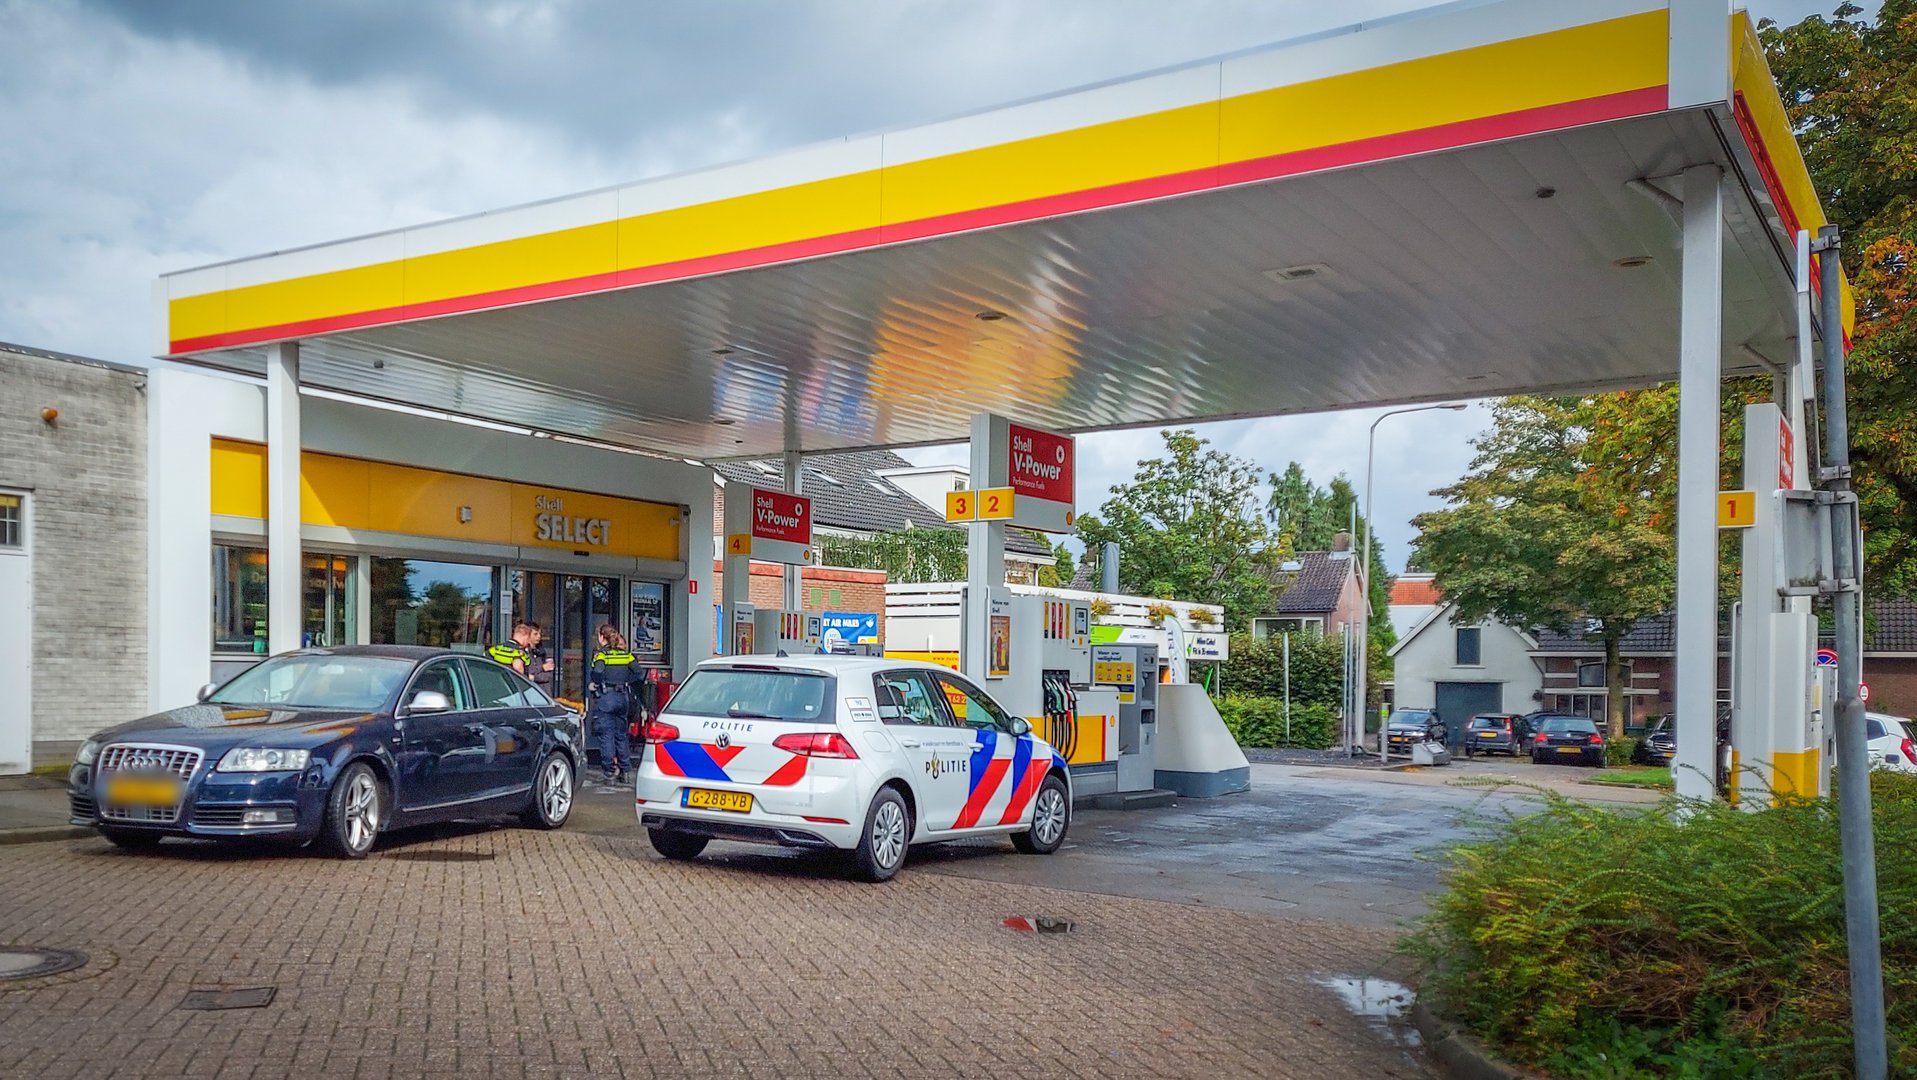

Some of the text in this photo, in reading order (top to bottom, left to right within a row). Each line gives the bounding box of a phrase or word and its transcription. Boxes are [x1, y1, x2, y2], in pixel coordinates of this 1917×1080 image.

[1013, 435, 1032, 454] Shell
[1013, 452, 1061, 480] V-Power
[535, 496, 563, 511] Shell
[757, 496, 773, 509] Shell
[955, 498, 967, 514] 3
[987, 496, 999, 512] 2
[1727, 500, 1736, 518] 1
[757, 508, 800, 528] V-Power
[536, 513, 611, 545] SELECT
[733, 539, 740, 550] 4
[830, 618, 842, 627] AIR
[702, 721, 754, 732] POLITIE
[925, 760, 967, 779] POLITIE
[692, 791, 748, 808] G-288-VB
